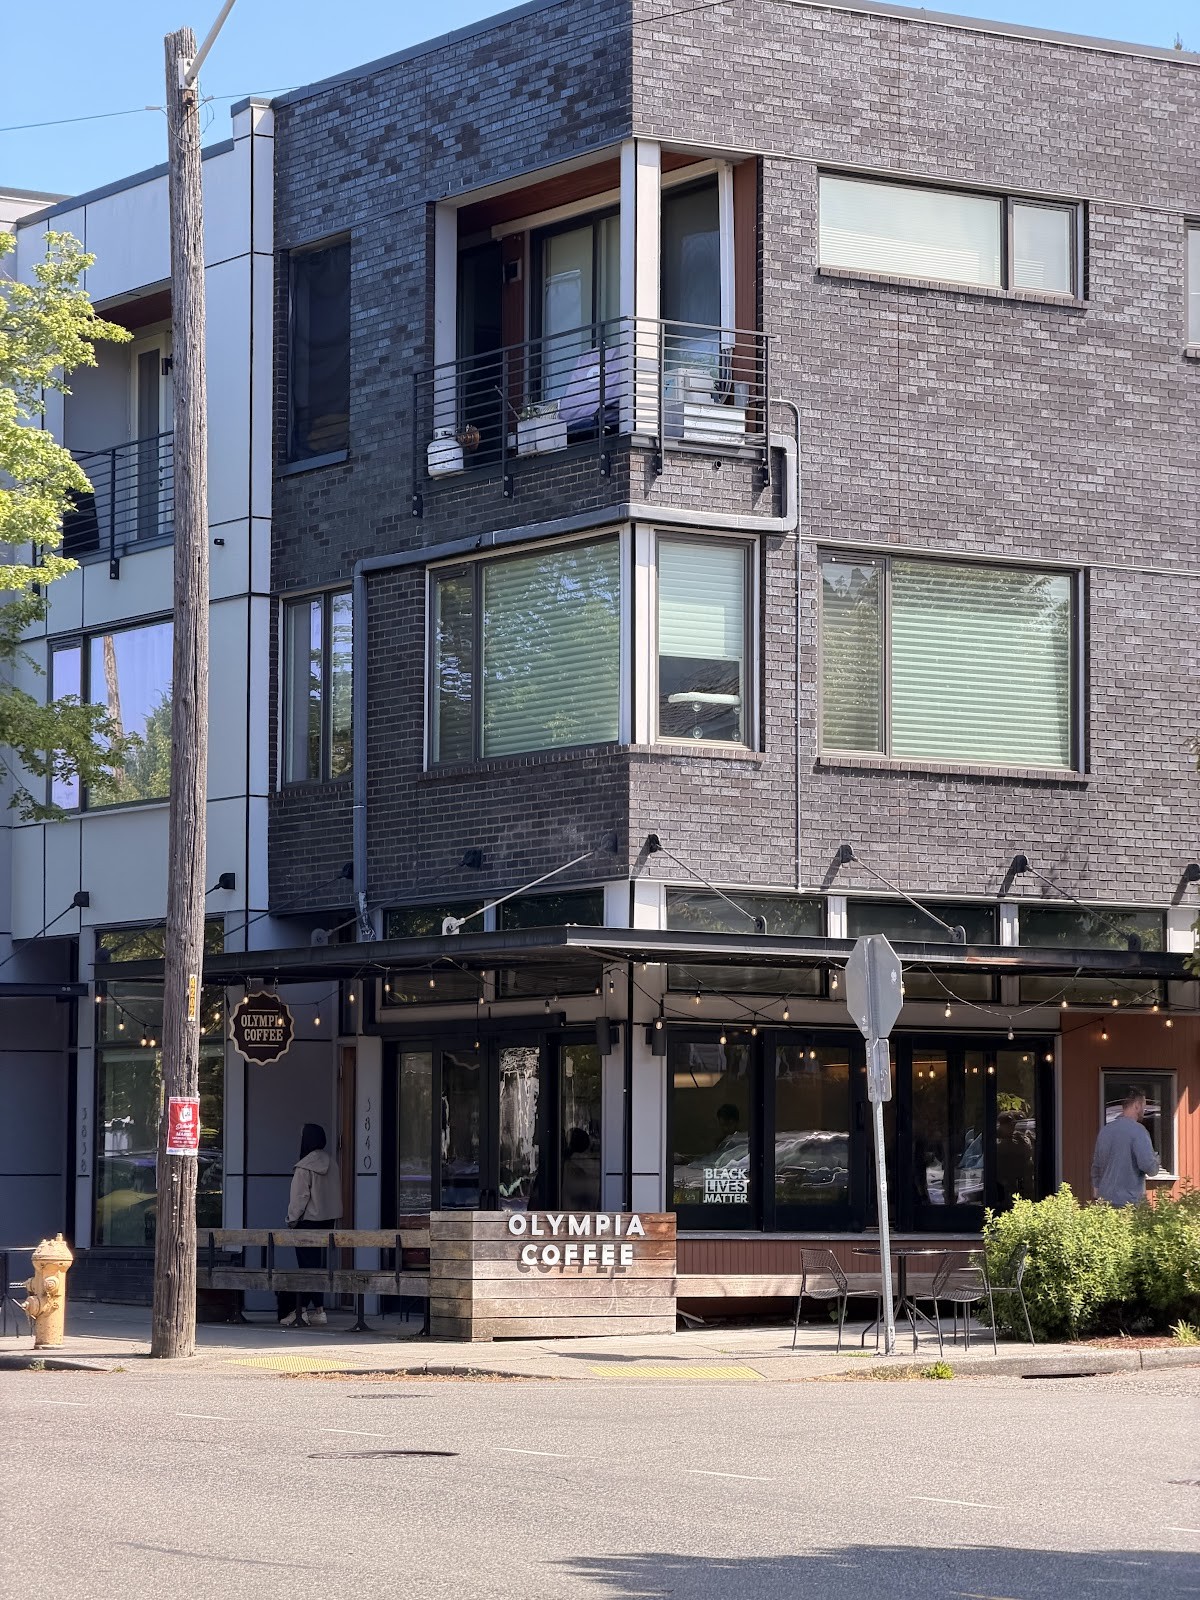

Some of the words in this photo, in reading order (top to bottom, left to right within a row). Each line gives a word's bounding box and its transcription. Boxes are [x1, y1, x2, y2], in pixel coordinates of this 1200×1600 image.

[244, 1028, 284, 1042] COFFEE
[704, 1168, 748, 1180] BLACK
[707, 1180, 746, 1193] LIVES
[703, 1193, 748, 1204] MATTER
[508, 1214, 646, 1237] OLYMPIA
[521, 1243, 634, 1267] COFFEE
